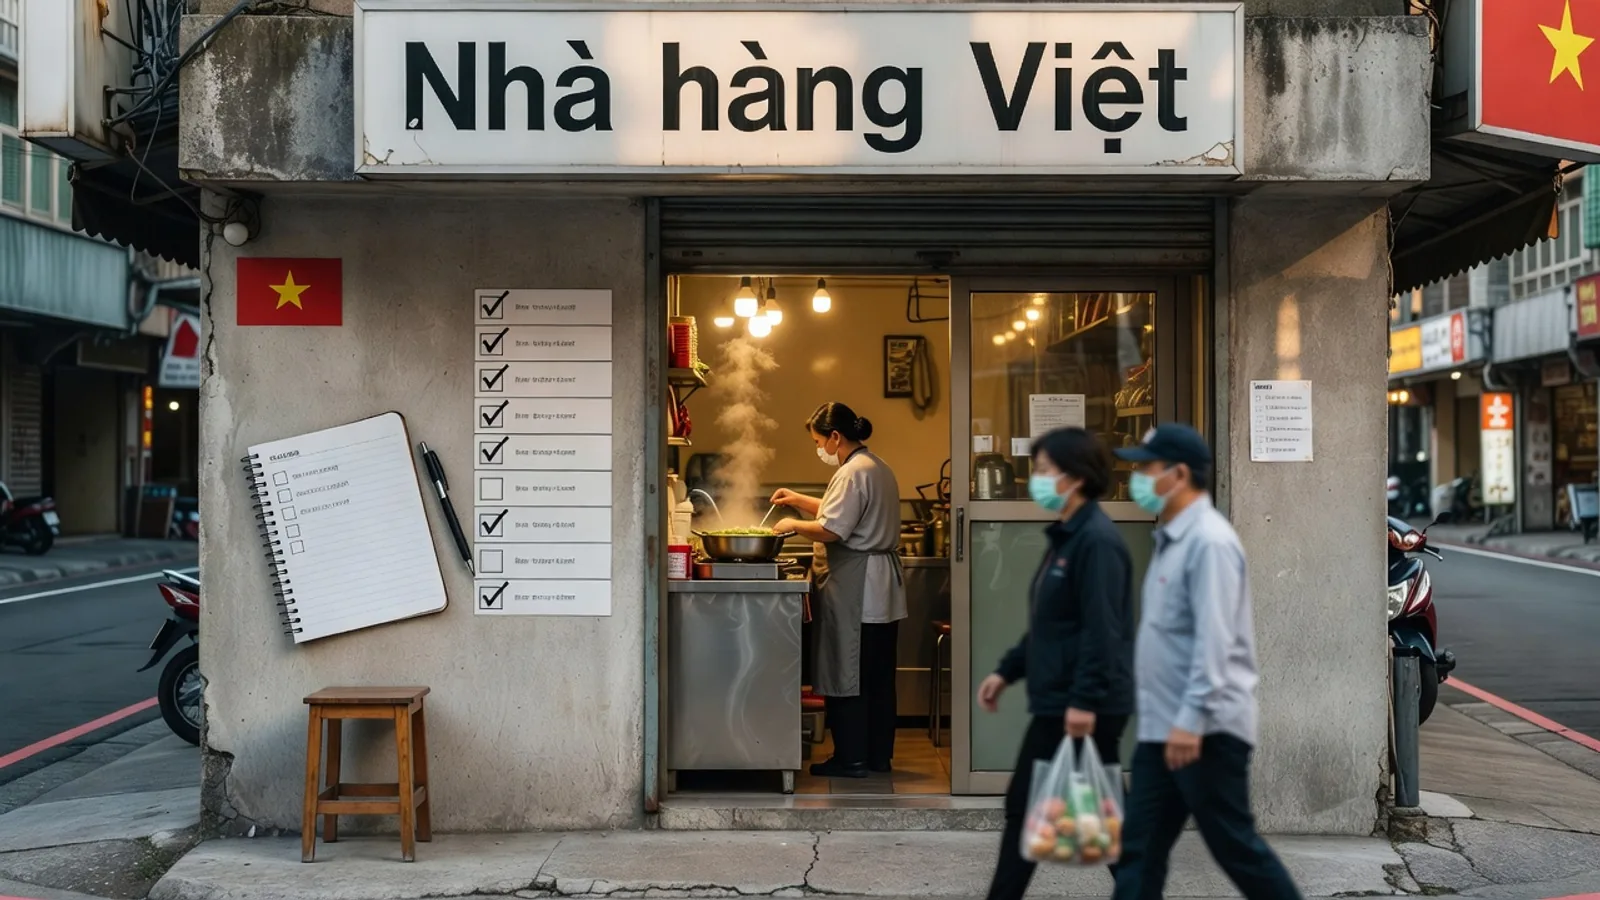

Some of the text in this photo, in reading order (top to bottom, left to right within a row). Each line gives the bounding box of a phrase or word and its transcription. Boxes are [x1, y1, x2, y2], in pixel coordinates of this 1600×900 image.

[405, 40, 1188, 154] Nhà hàng Việt
